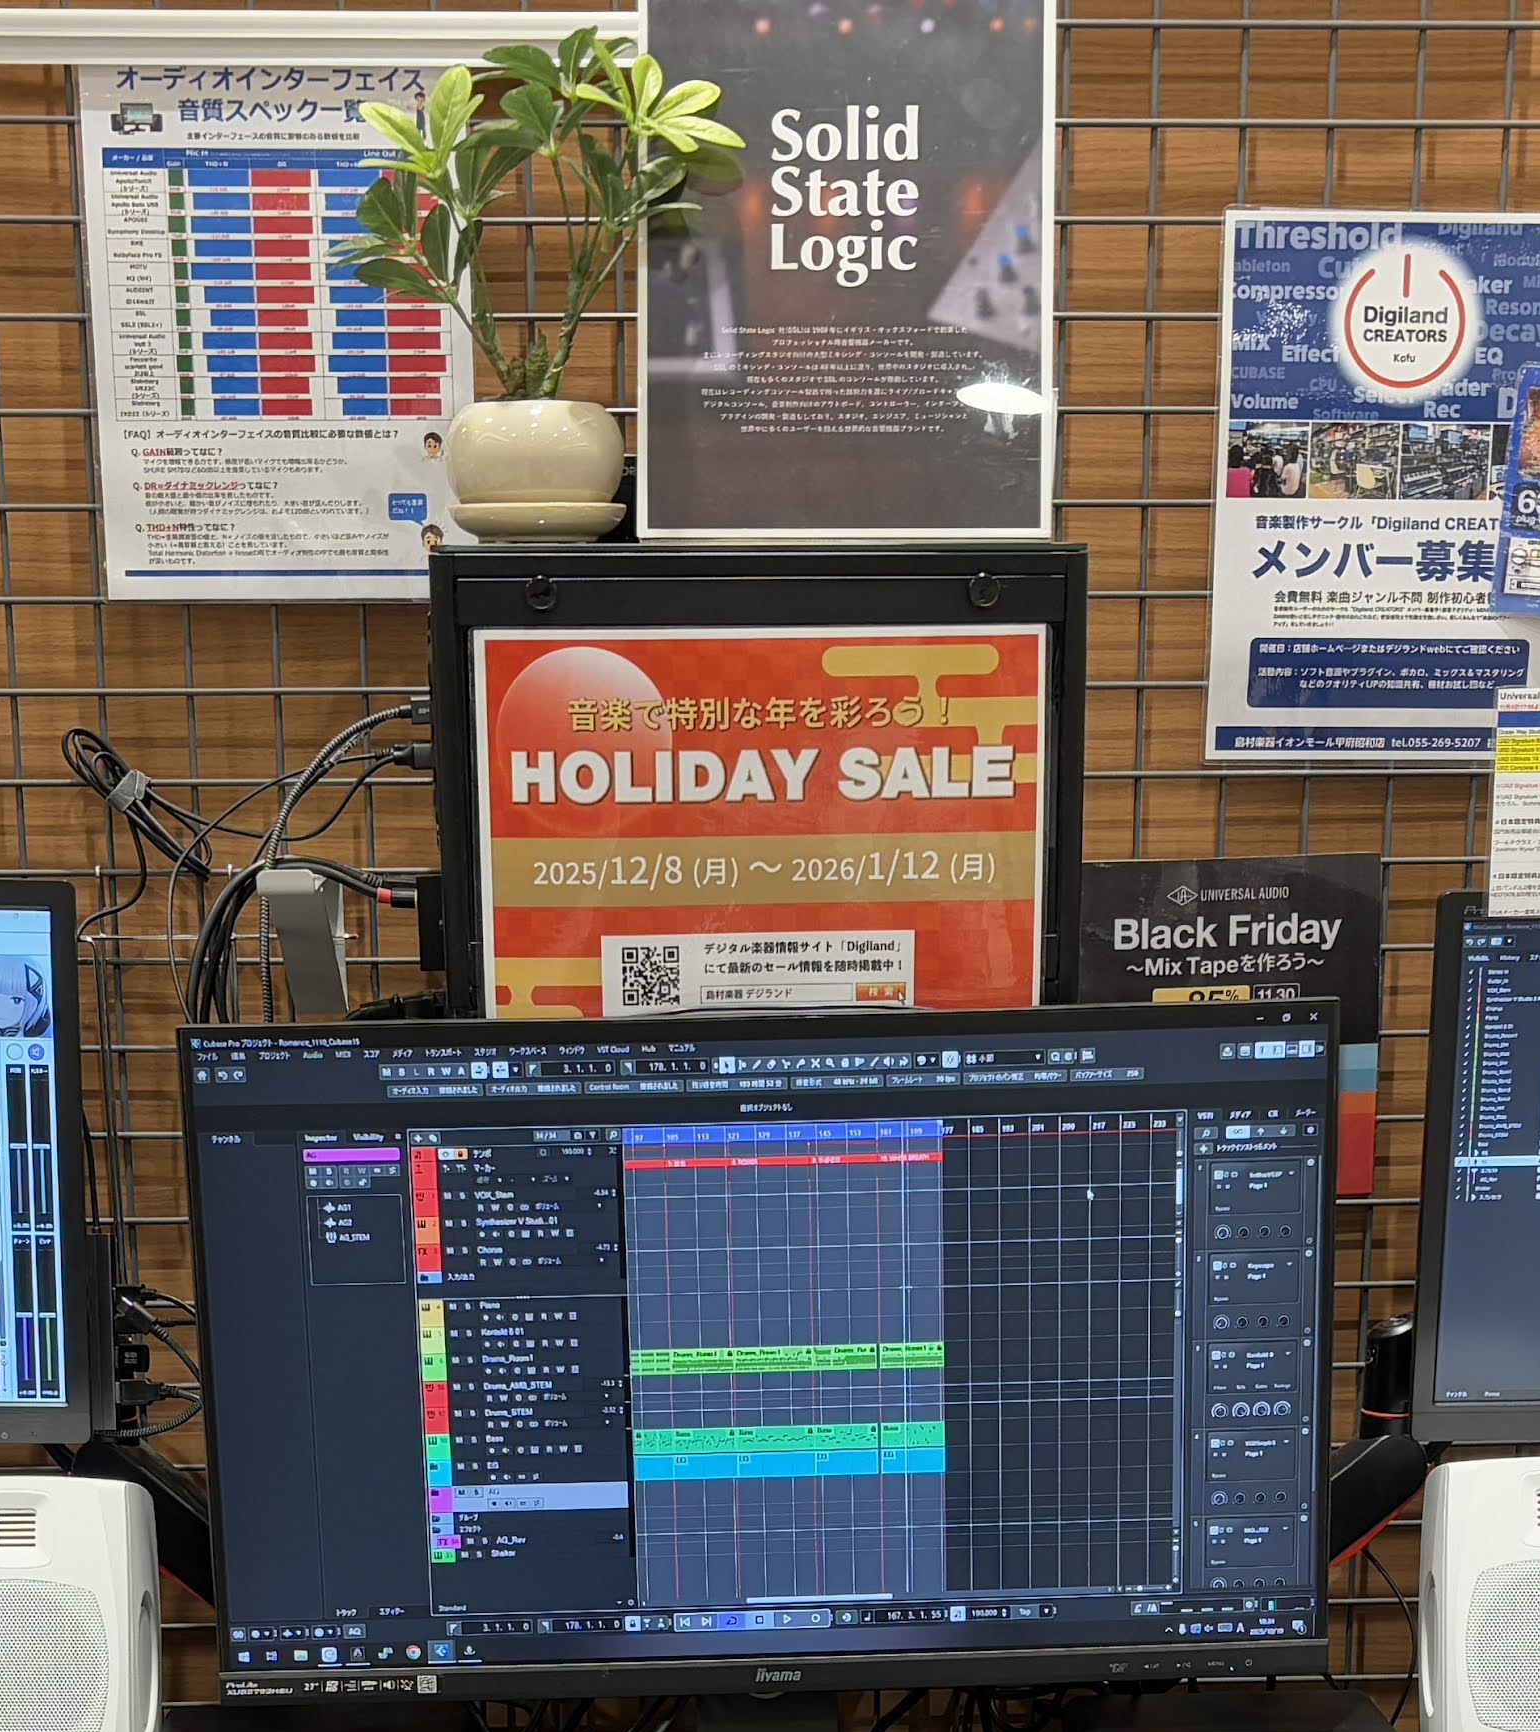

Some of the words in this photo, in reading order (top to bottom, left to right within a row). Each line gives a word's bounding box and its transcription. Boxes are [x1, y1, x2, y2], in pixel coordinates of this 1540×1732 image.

[116, 66, 425, 92] オーディオインターフェイス
[771, 105, 919, 162] Solid
[771, 165, 919, 218] State
[1235, 222, 1402, 251] Threshold
[771, 219, 918, 288] Logic
[1363, 306, 1448, 326] Digiland
[1363, 329, 1447, 343] CREATORS
[1393, 353, 1416, 364] Kofu
[1475, 347, 1503, 366] EQ
[1231, 393, 1298, 410] Volume
[1424, 400, 1461, 419] Rec
[1252, 540, 1495, 582] メンバー募集
[1274, 591, 1322, 604] 会費無料
[1327, 591, 1423, 604] 楽曲ジャンル不問
[567, 696, 950, 732] 音楽で特別な年を彩ろう！
[511, 747, 821, 805] HOLIDAY
[837, 745, 1016, 802] SALE
[534, 852, 683, 890] 2025/12/8
[693, 856, 738, 887] (月)
[791, 849, 940, 886] 2026/1/12
[950, 853, 996, 884] (月)
[1200, 888, 1255, 902] UNIVERSAL
[1259, 886, 1289, 899] AUDIO
[1114, 916, 1218, 951] Black
[1229, 912, 1343, 951] Friday
[746, 988, 792, 999] デジランド
[303, 1051, 323, 1059] Audio
[756, 1666, 801, 1683] iiyama
